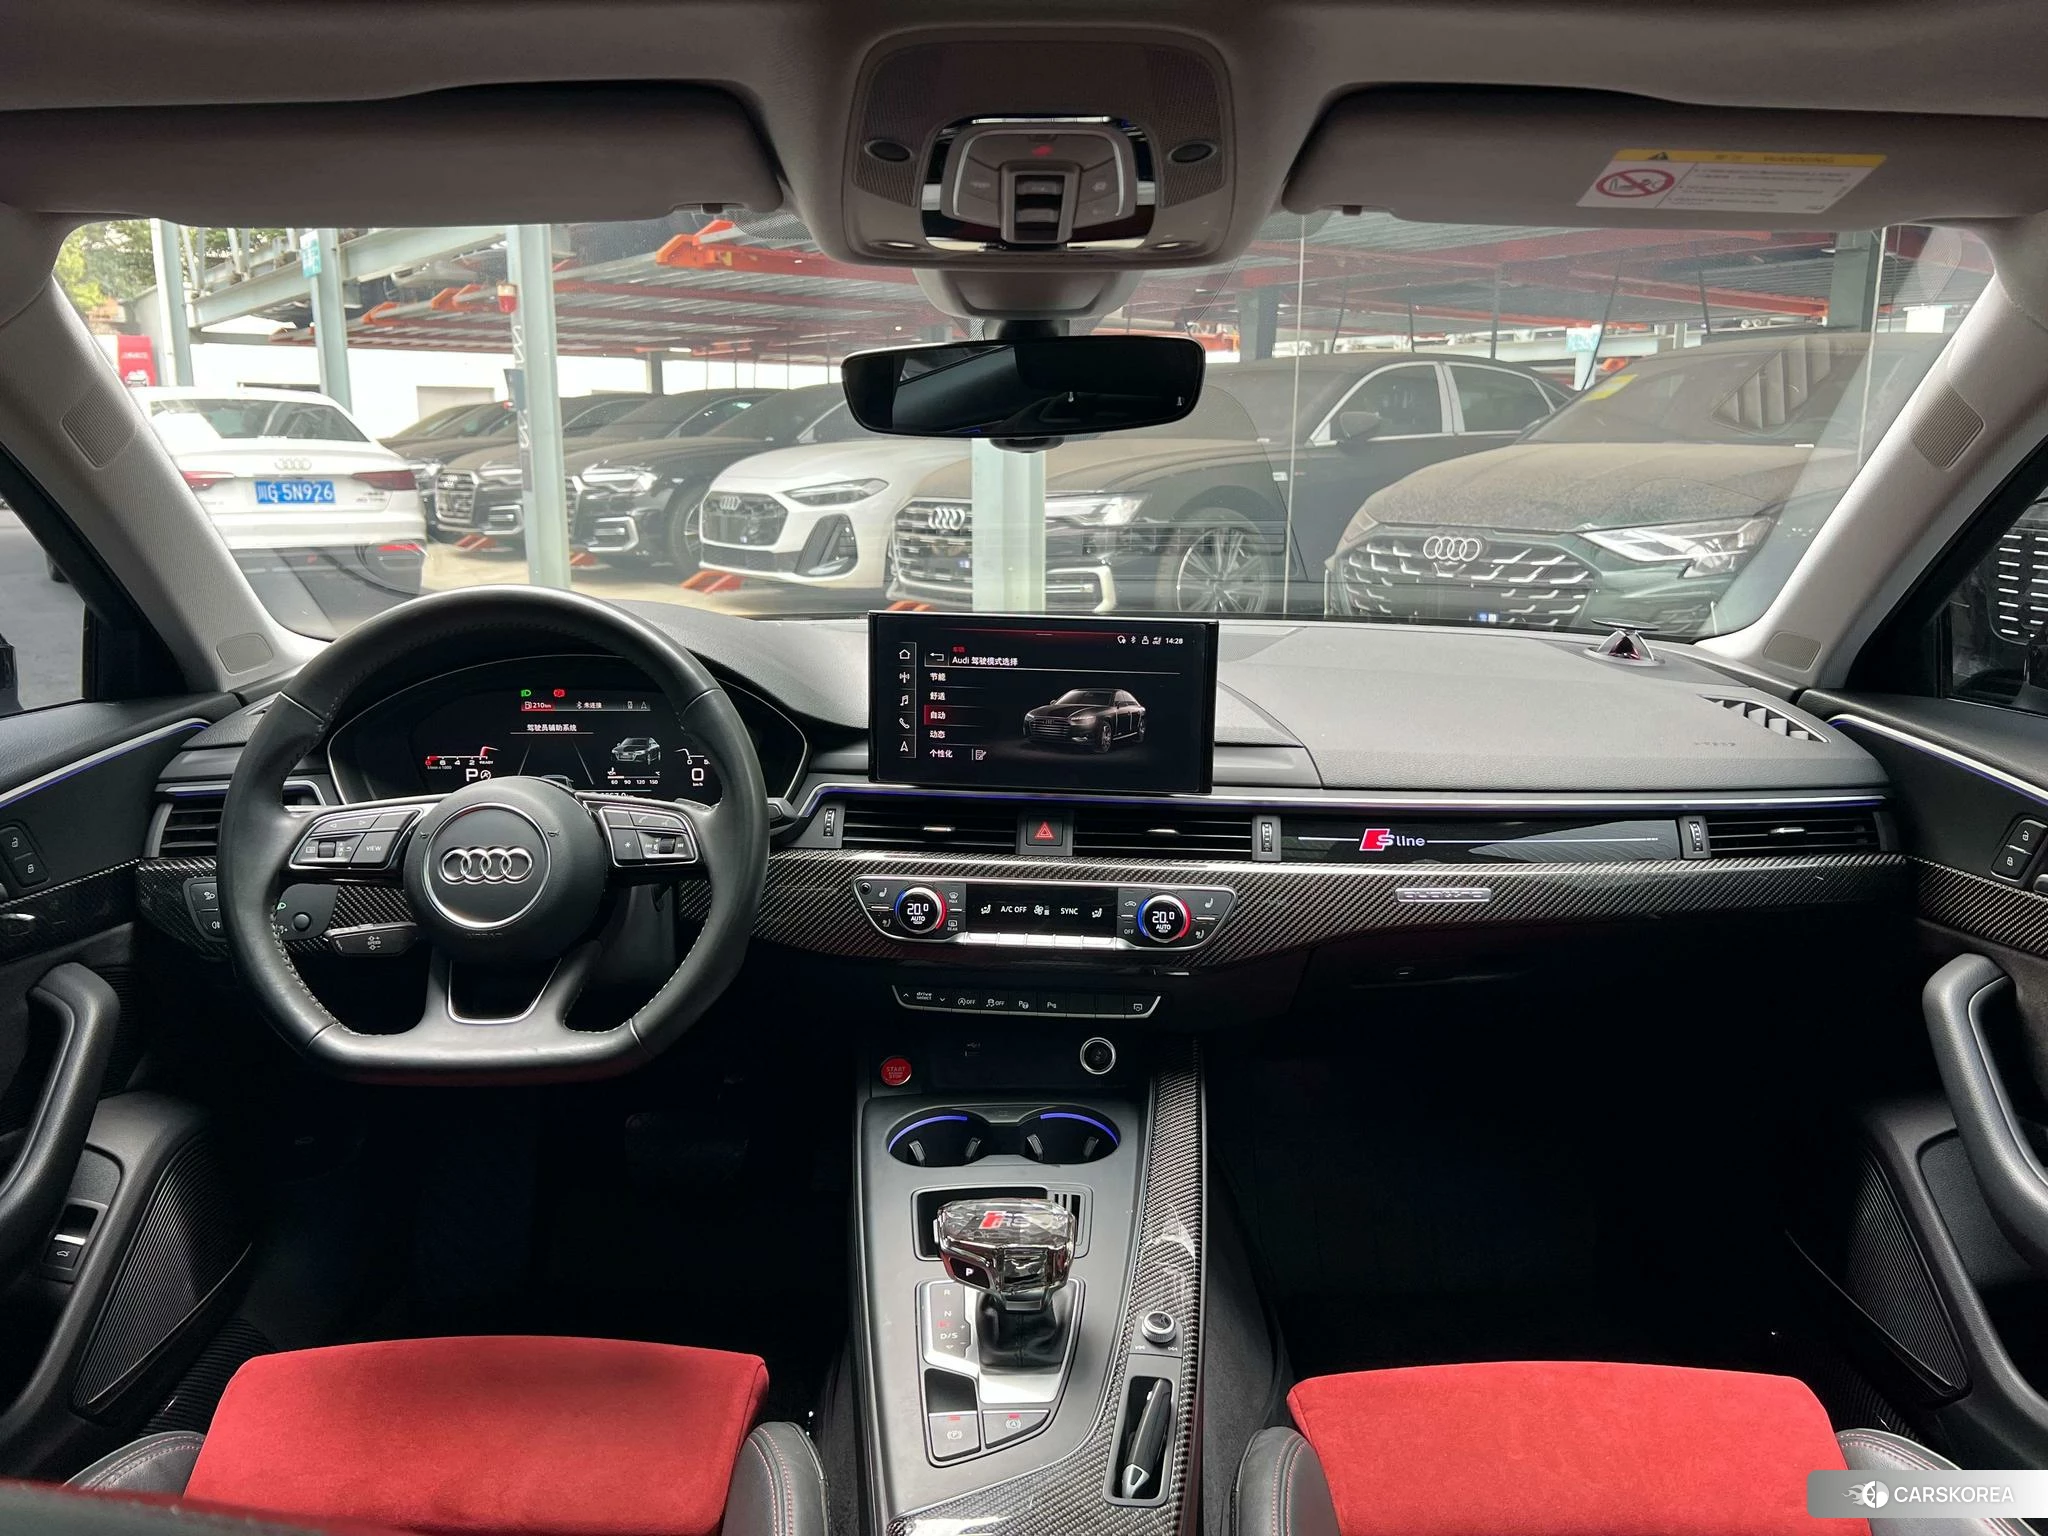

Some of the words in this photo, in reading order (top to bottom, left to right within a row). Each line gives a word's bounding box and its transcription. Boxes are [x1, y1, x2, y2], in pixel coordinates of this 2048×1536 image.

[951, 656, 970, 665] Audi
[971, 657, 1018, 666] 驾驶模式选择
[929, 673, 946, 681] 节能
[929, 691, 946, 700] 舒适
[930, 711, 946, 720] 自动
[526, 724, 577, 732] 驾驶员辅助系统
[929, 730, 946, 739] 动态
[929, 749, 953, 758] 个性化
[465, 764, 479, 782] P
[691, 768, 704, 781] 0
[1000, 905, 1013, 913] A/C
[1060, 907, 1079, 915] SYNC
[965, 1267, 974, 1276] P
[940, 1332, 958, 1340] D/S
